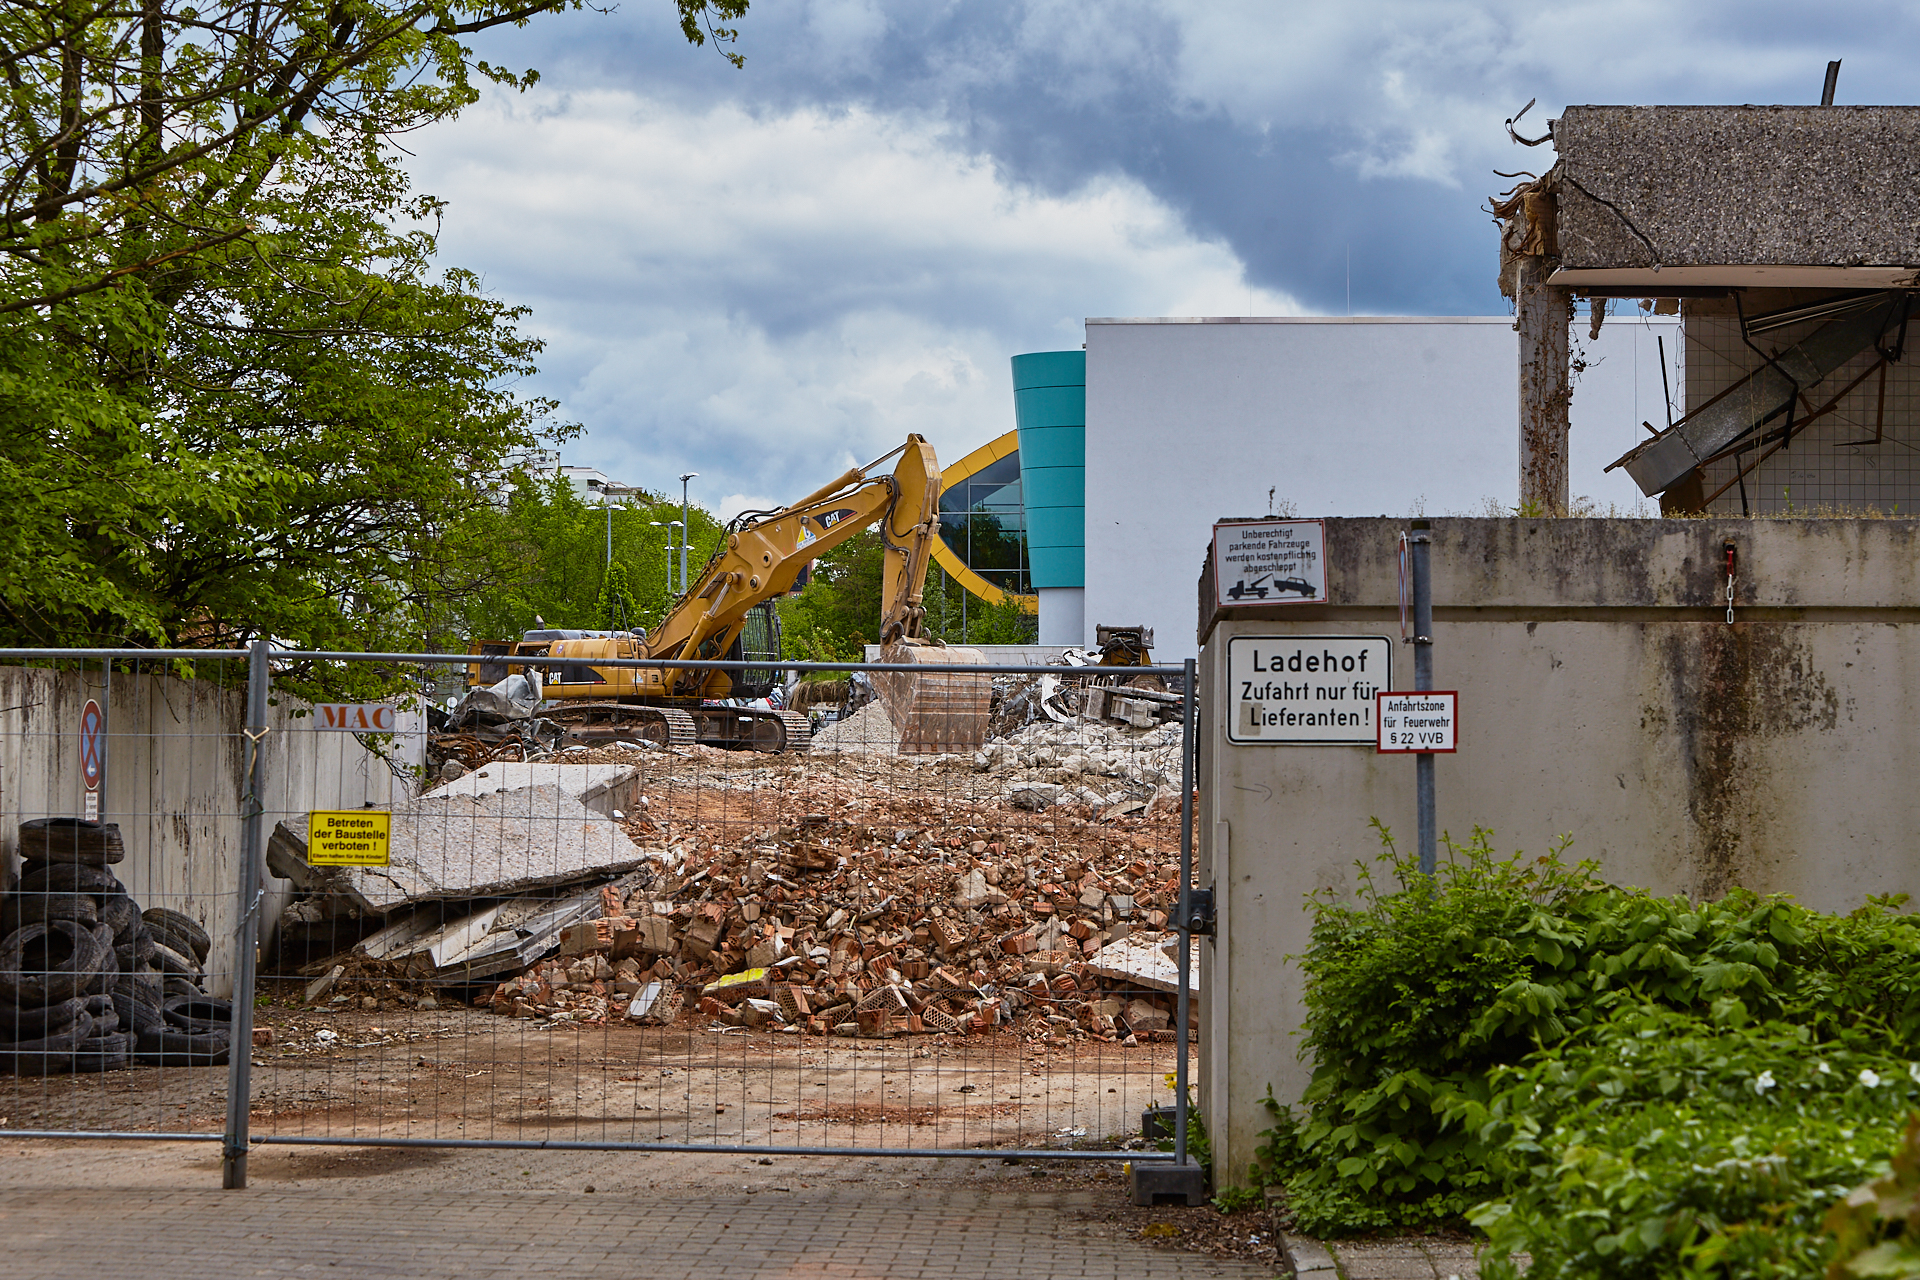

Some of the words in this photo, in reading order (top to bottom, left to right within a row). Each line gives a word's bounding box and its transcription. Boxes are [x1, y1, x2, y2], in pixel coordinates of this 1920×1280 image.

[825, 511, 840, 528] CAT
[1242, 528, 1293, 539] Unberechtigt
[1229, 541, 1266, 552] parkende
[1268, 540, 1310, 550] Fahrzeuge
[1225, 552, 1255, 562] werden
[1256, 550, 1316, 561] kostenpflichtig
[1243, 562, 1297, 574] abgeschleppt
[1254, 650, 1368, 672] Ladehof
[549, 672, 562, 685] CAT
[1242, 682, 1309, 700] Zufahrt
[1316, 686, 1346, 700] nur
[1353, 682, 1379, 700] für
[1387, 700, 1445, 712] Anfahrtszone
[320, 706, 394, 730] MAC
[1384, 716, 1396, 728] für
[1404, 716, 1450, 728] Feuerwehr
[1401, 732, 1414, 744] 22
[1419, 732, 1444, 744] VVB
[327, 818, 373, 828] Betreten
[314, 829, 332, 838] der
[335, 829, 386, 840] Baustelle
[322, 841, 369, 851] verboten
